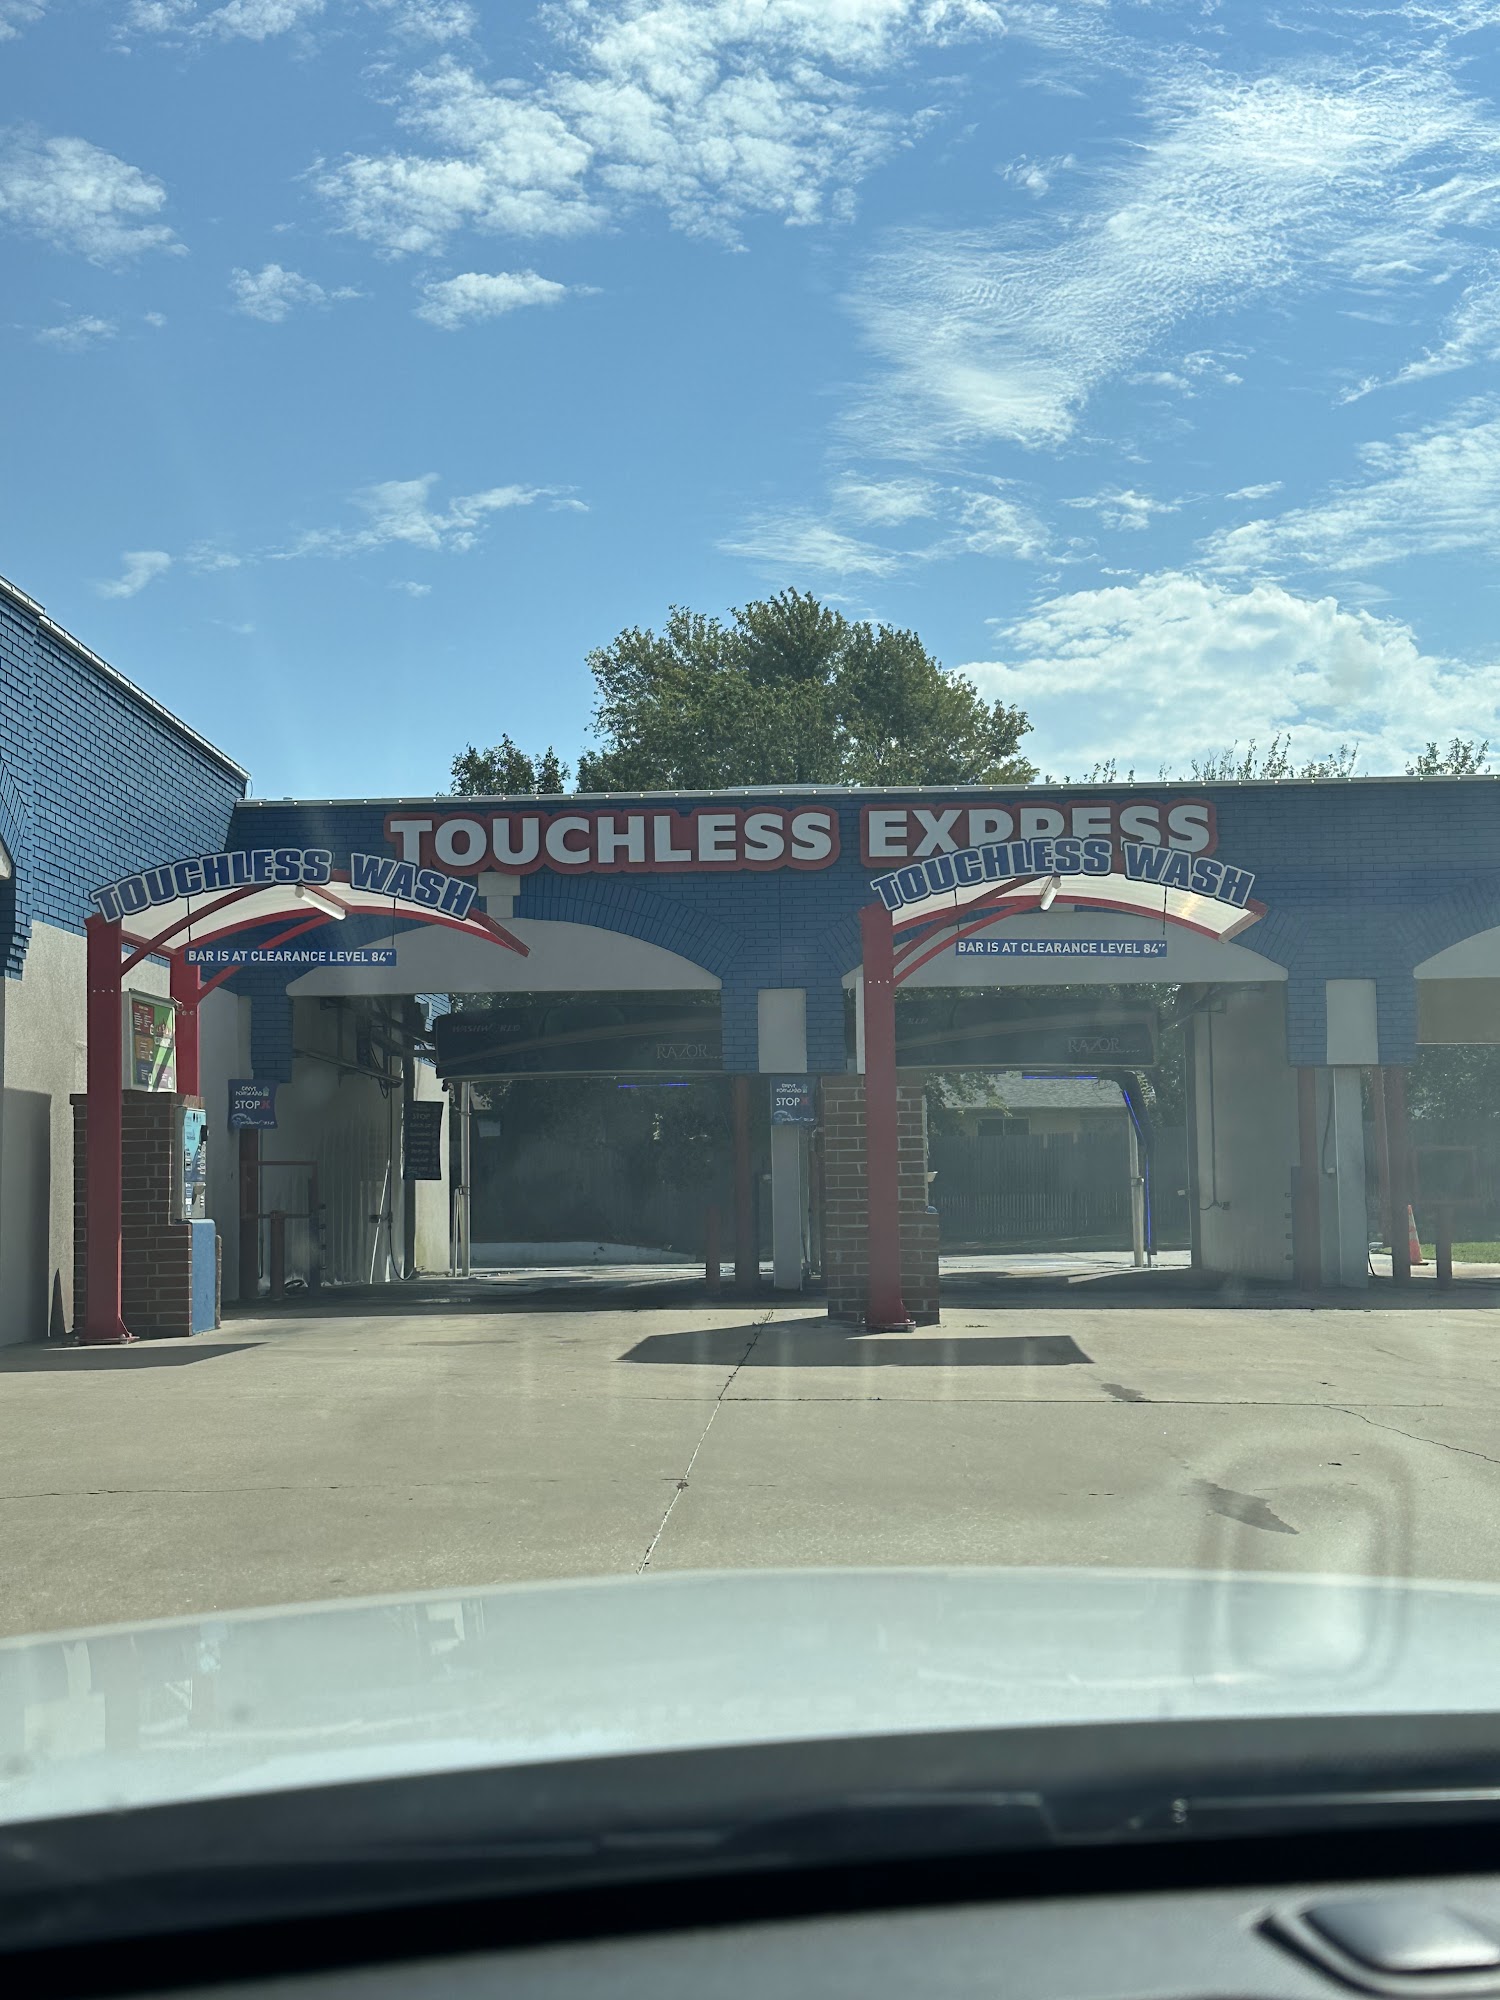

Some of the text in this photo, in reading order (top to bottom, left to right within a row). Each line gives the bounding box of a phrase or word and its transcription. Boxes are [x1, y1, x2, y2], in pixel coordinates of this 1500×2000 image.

[390, 812, 832, 867] TOUCHLESS
[870, 838, 1256, 912] TOUCHLESS WASH
[92, 849, 478, 923] TOUCHLESS WASH
[188, 950, 214, 962] BAR
[217, 950, 229, 962] IS
[234, 951, 247, 962] AT
[250, 951, 326, 962] CLEARANCE
[329, 951, 368, 962] LEVEL
[958, 941, 984, 953] BAR
[987, 941, 999, 953] IS
[1002, 942, 1018, 953] AT
[1021, 942, 1097, 954] CLEARANCE
[1100, 943, 1140, 954] LEVEL
[656, 1043, 708, 1060] RAZOR
[1067, 1036, 1120, 1053] RAZOR
[234, 1100, 261, 1109] STOP
[775, 1097, 800, 1106] STOP
